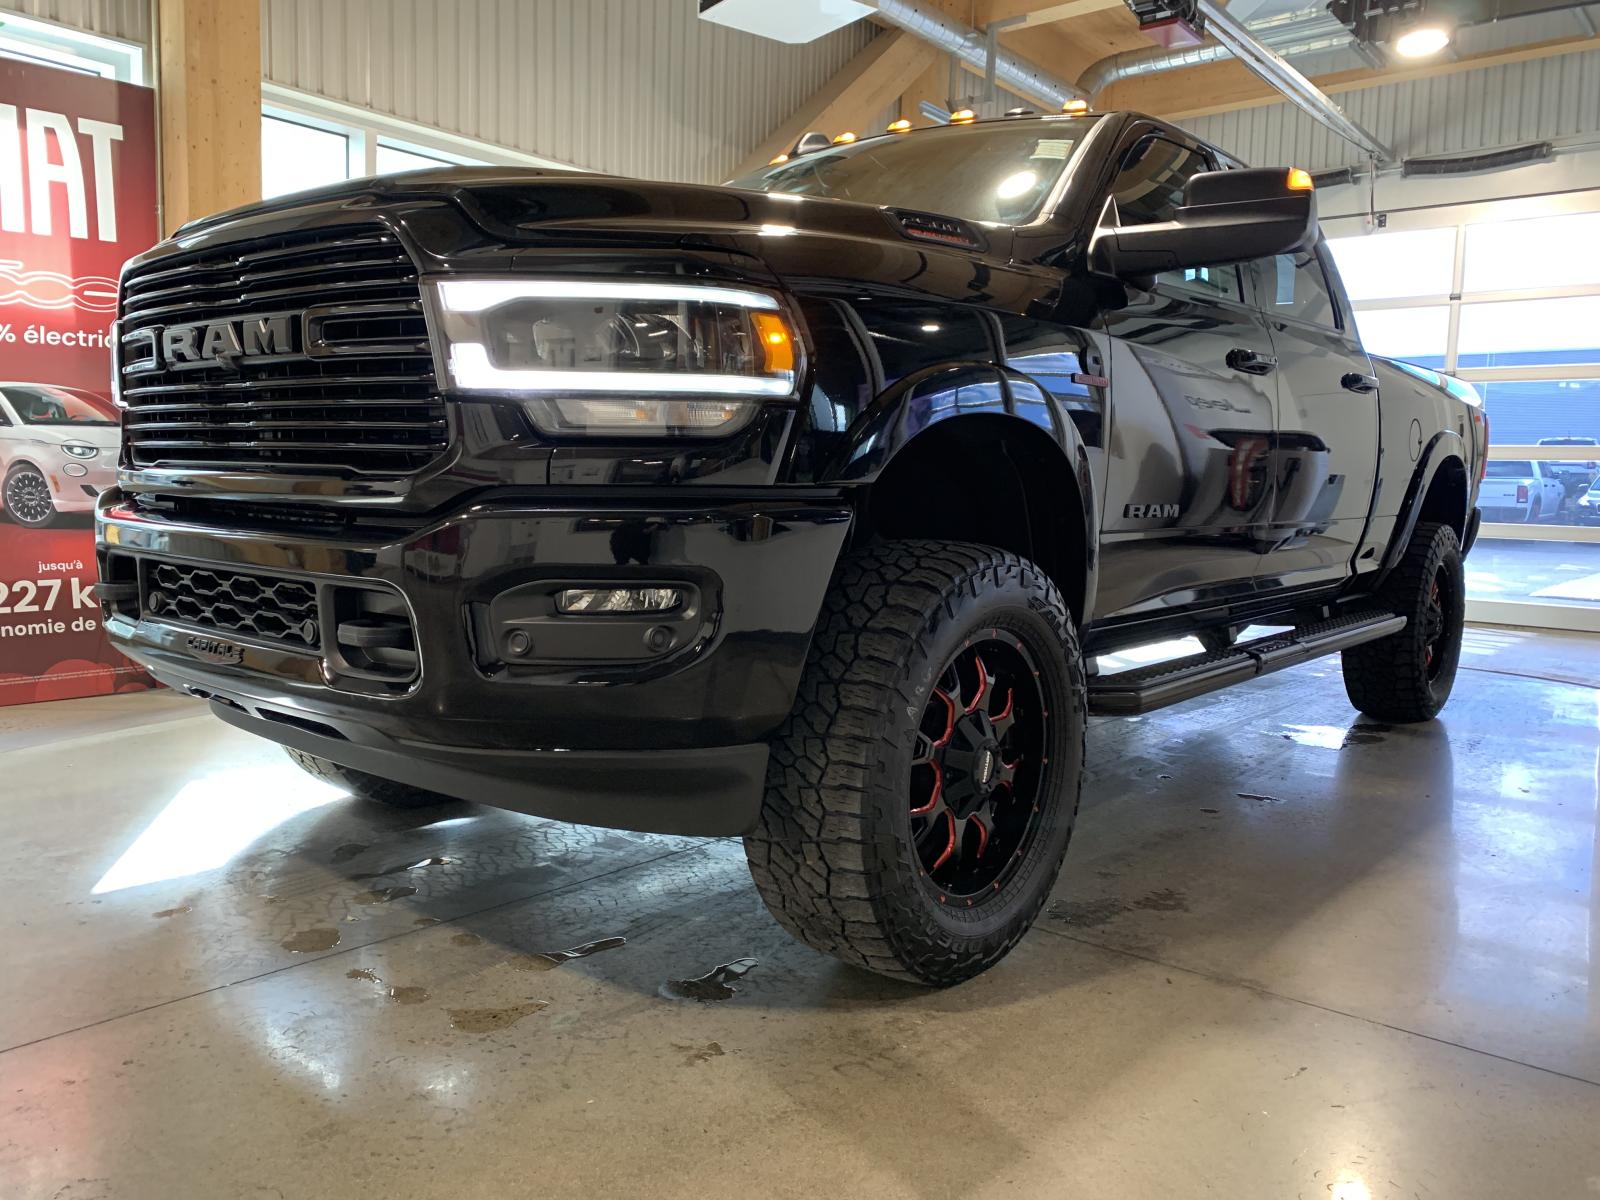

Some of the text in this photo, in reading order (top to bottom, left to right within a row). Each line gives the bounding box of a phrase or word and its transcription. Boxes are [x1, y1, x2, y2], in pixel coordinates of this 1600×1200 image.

[163, 315, 293, 363] RAM
[1123, 503, 1180, 519] RAM
[38, 560, 84, 574] jusqu'à
[71, 616, 97, 632] de
